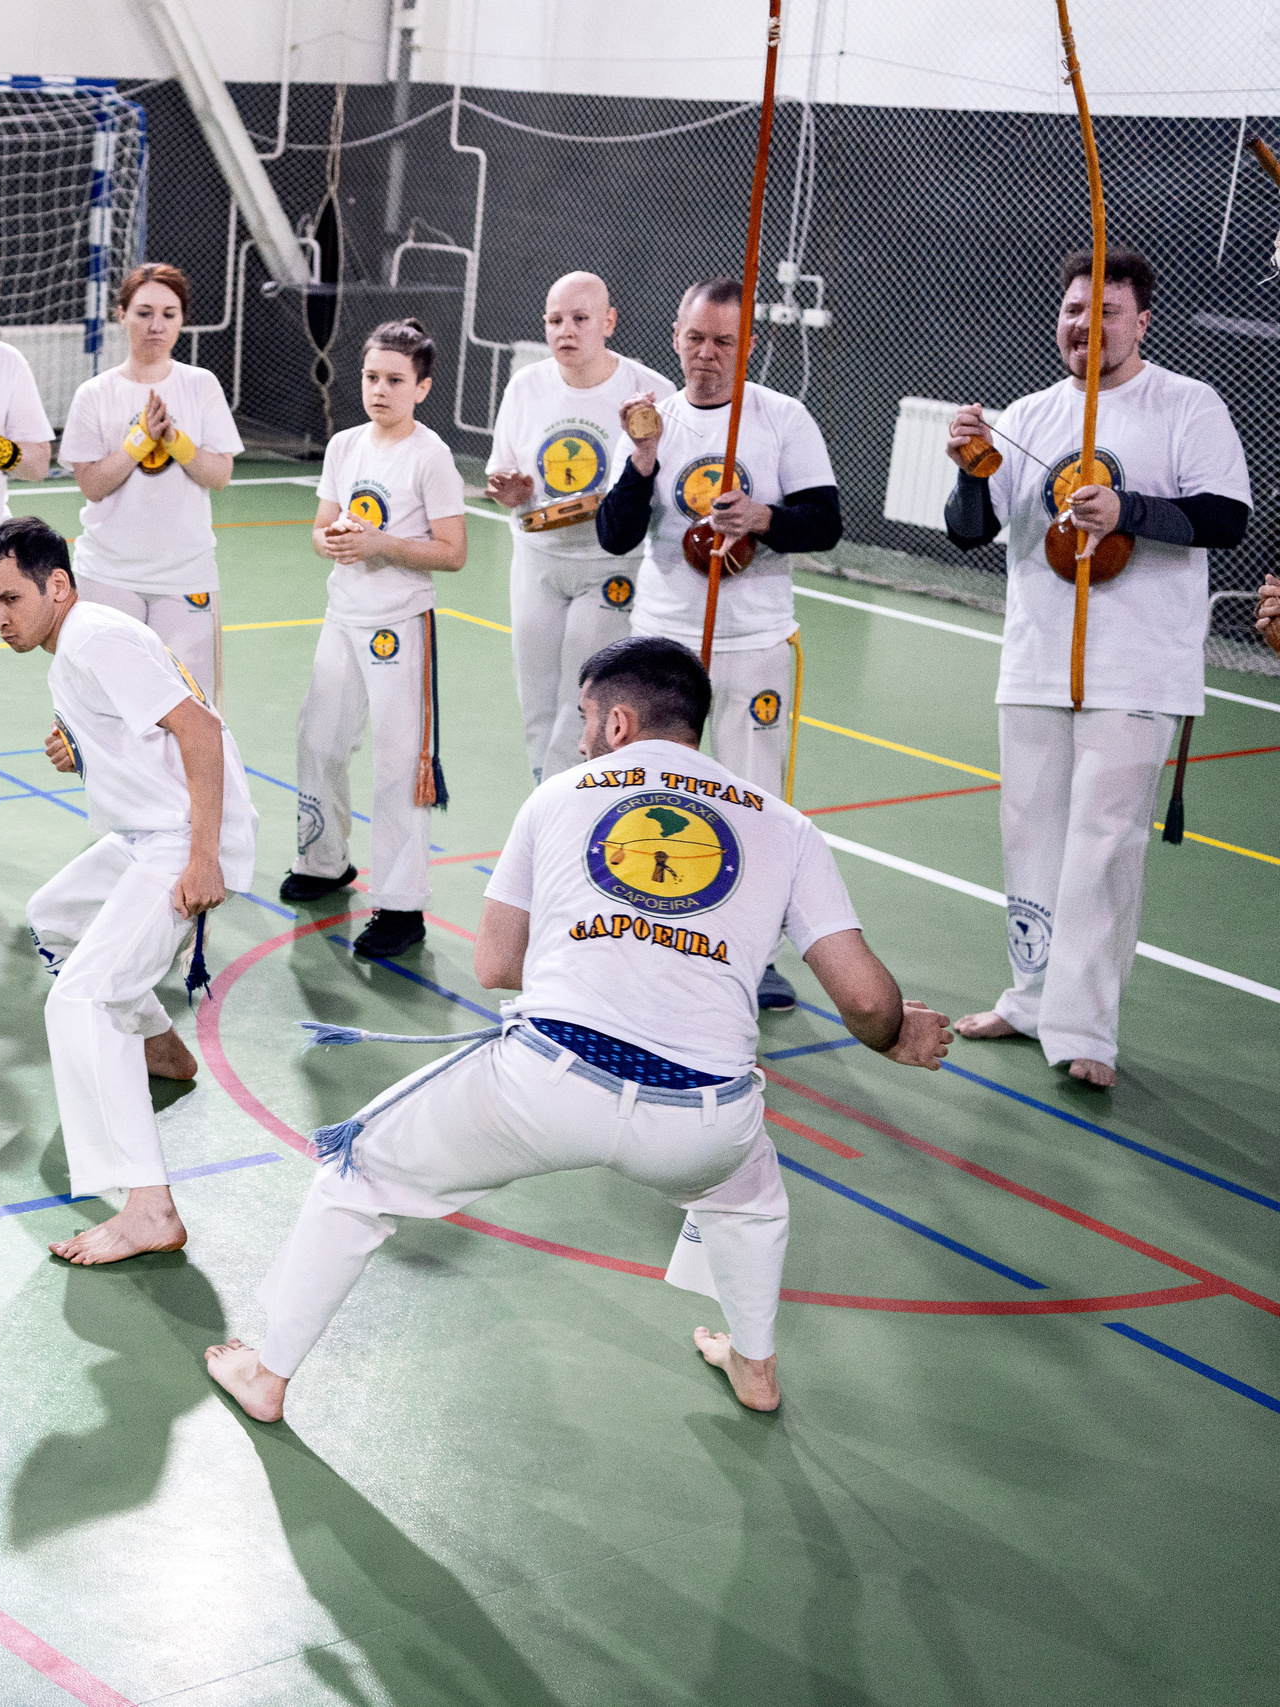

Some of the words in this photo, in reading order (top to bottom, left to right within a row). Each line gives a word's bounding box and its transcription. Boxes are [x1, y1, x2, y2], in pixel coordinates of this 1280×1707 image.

[576, 767, 645, 790] AXÉ
[661, 771, 764, 812] TITAN
[616, 795, 682, 814] GRUPO
[611, 884, 700, 911] CAPOEIRA
[569, 914, 730, 966] CAPOEIRA
